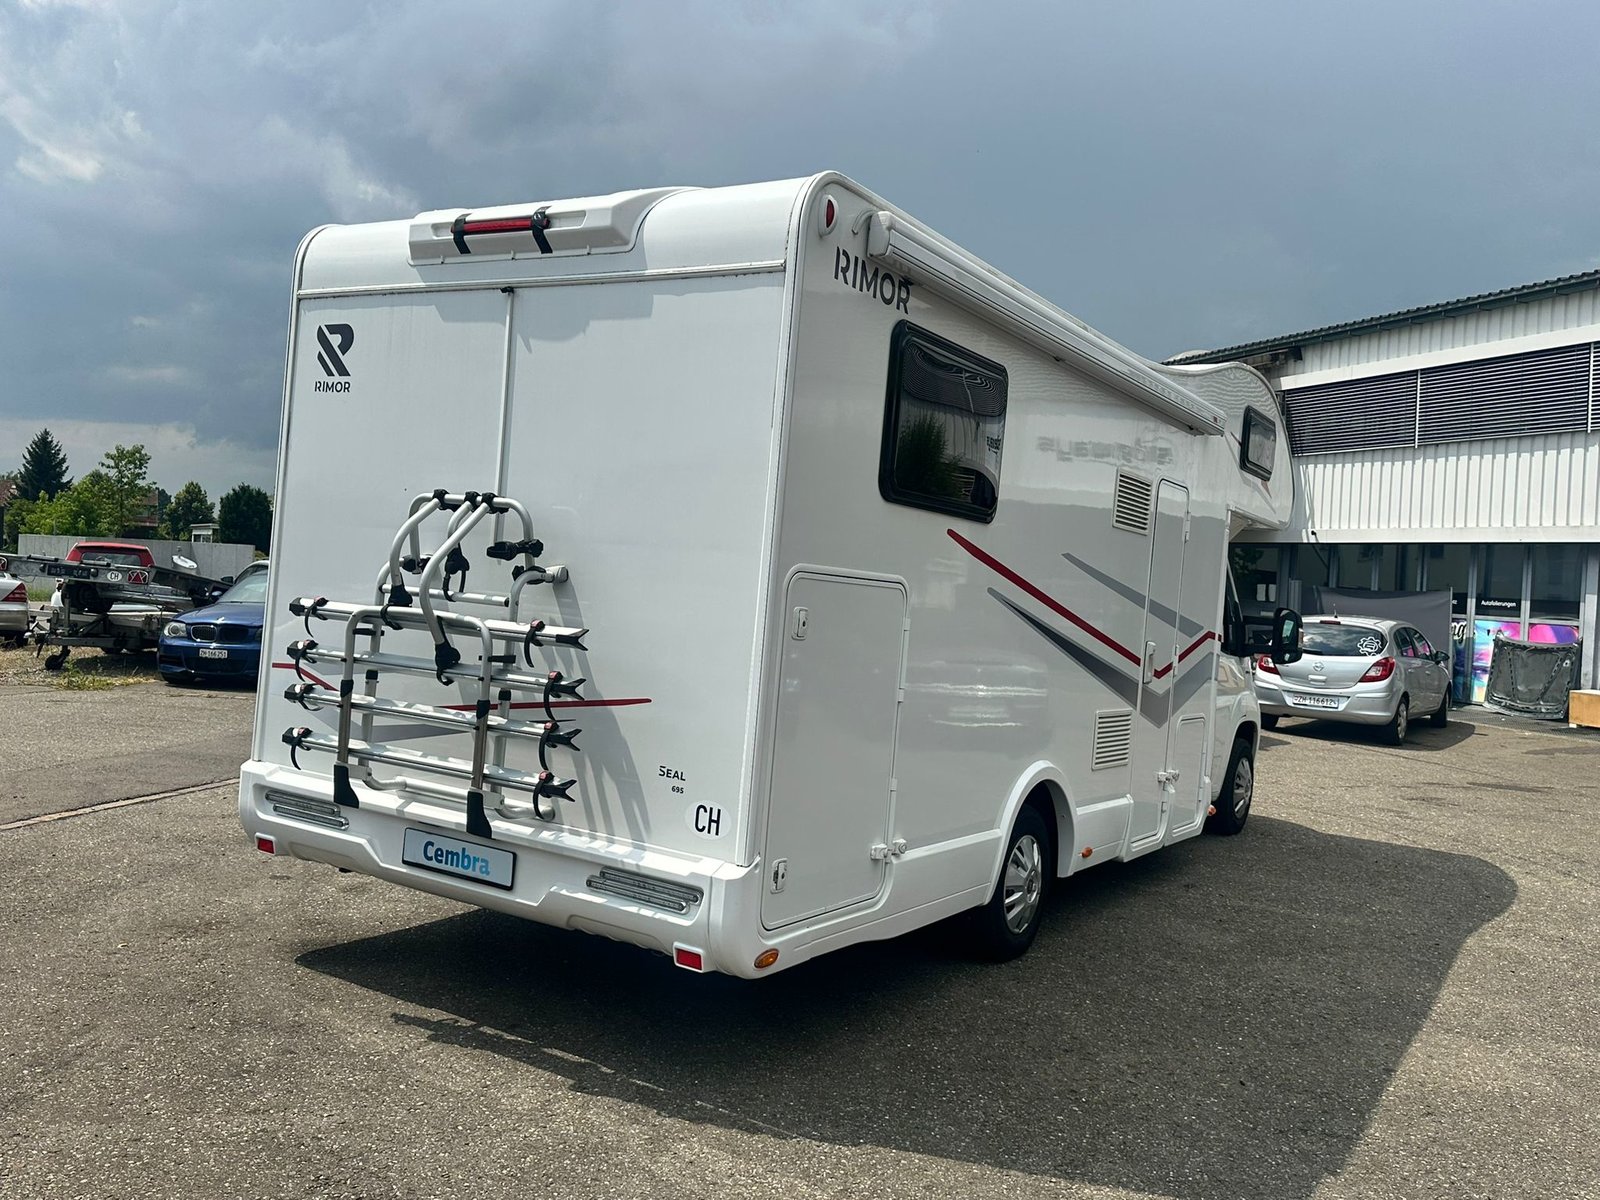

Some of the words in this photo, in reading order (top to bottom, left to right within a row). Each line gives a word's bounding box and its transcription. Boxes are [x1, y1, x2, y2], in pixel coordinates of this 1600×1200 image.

[833, 246, 911, 315] RIMOR
[314, 380, 351, 393] RIMOR
[110, 571, 119, 580] CH
[658, 765, 686, 782] SEAL
[671, 785, 684, 794] 695
[694, 804, 722, 837] CH
[423, 840, 491, 877] Cembra
